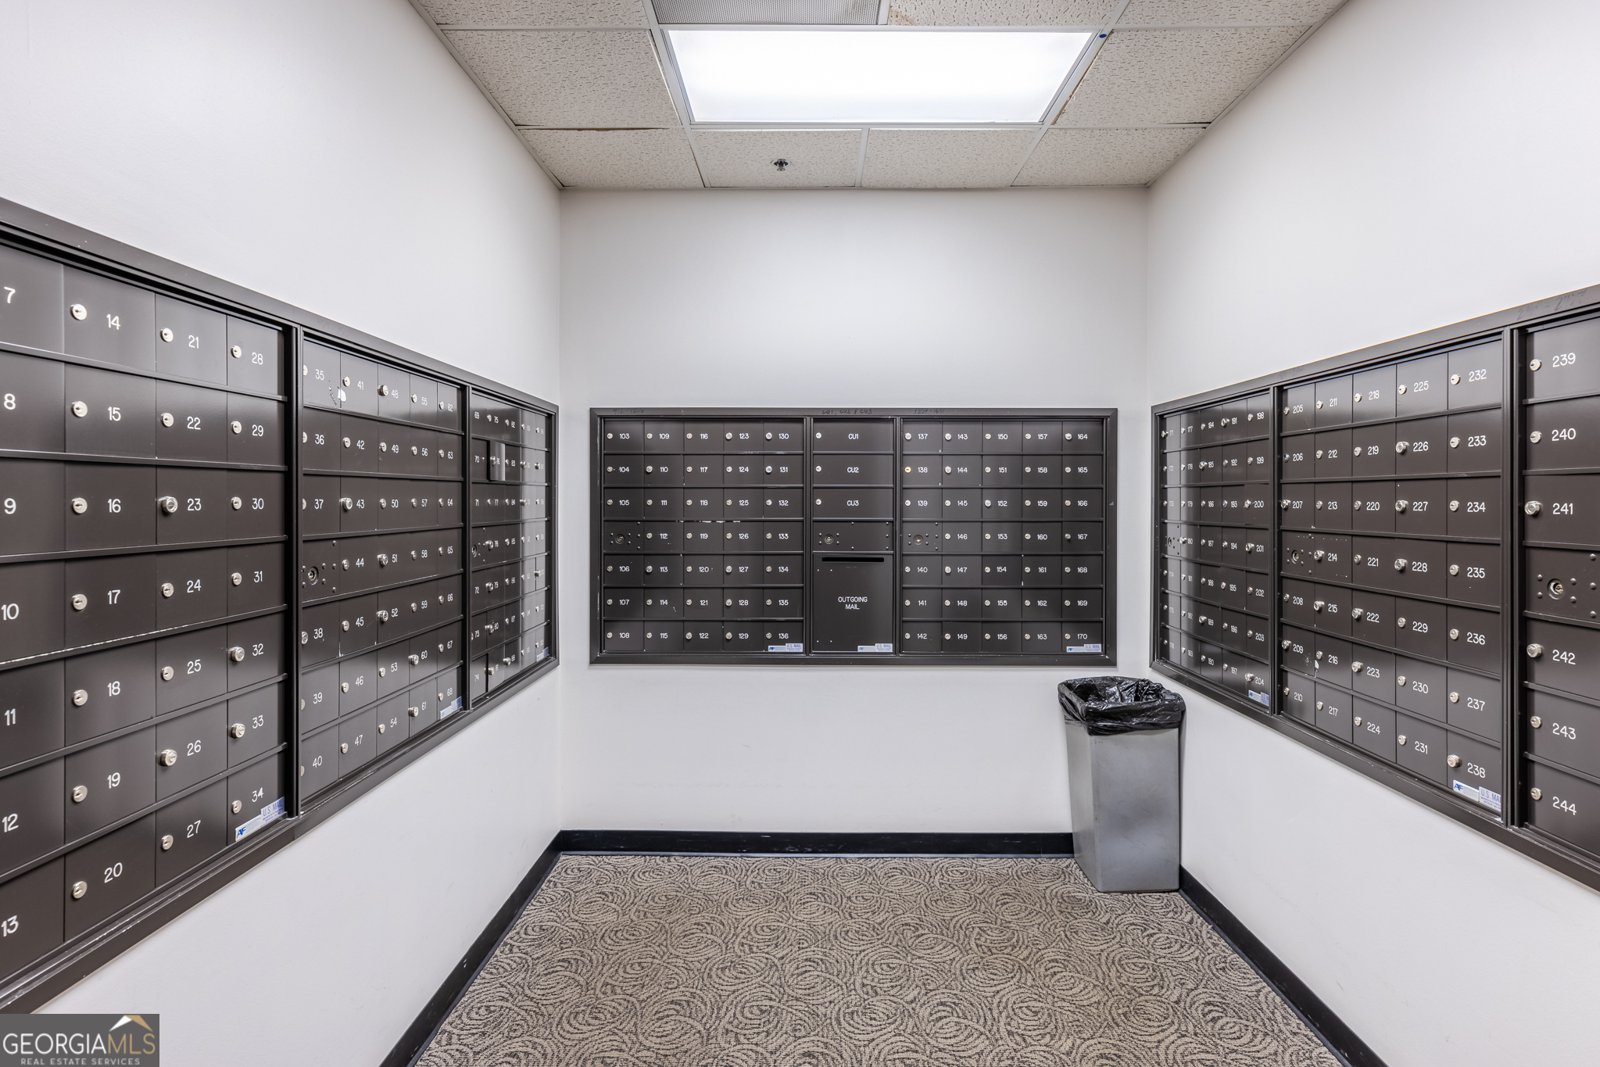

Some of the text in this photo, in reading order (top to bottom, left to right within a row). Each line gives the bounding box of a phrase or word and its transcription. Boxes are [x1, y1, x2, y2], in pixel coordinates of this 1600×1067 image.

[4, 286, 16, 304] 7
[106, 314, 121, 330] 14
[188, 335, 199, 349] 21
[251, 352, 263, 365] 28
[1552, 352, 1576, 368] 239
[315, 369, 325, 381] 35
[1468, 369, 1487, 382] 232
[1413, 380, 1429, 392] 225
[1368, 390, 1380, 400] 218
[4, 393, 16, 410] 8
[1329, 397, 1338, 407] 211
[108, 406, 121, 421] 15
[1293, 403, 1304, 414] 205
[187, 416, 201, 430] 22
[252, 424, 264, 437] 29
[1552, 428, 1576, 441] 240
[315, 434, 325, 445] 36
[356, 440, 365, 450] 42
[1468, 435, 1487, 447] 233
[391, 444, 399, 454] 49
[1368, 445, 1379, 455] 219
[1413, 441, 1429, 452] 226
[1293, 453, 1303, 462] 206
[1328, 449, 1338, 459] 212
[4, 498, 16, 514] 9
[108, 498, 121, 513] 16
[187, 498, 202, 511] 23
[252, 498, 264, 510] 30
[314, 499, 324, 510] 37
[356, 499, 365, 509] 43
[391, 499, 399, 508] 50
[1292, 500, 1303, 509] 207
[1328, 501, 1338, 510] 213
[1366, 501, 1380, 511] 220
[1413, 501, 1428, 511] 227
[1467, 502, 1486, 512] 234
[1553, 503, 1573, 515] 241
[355, 558, 364, 567] 44
[1328, 553, 1338, 562] 214
[1367, 557, 1379, 567] 221
[1412, 561, 1428, 573] 228
[1467, 567, 1485, 579] 235
[254, 571, 263, 583] 31
[187, 579, 201, 593] 24
[107, 589, 121, 605] 17
[1293, 596, 1303, 606] 208
[1, 603, 19, 621] 10
[1328, 603, 1338, 613] 215
[355, 616, 364, 627] 45
[1366, 612, 1379, 623] 222
[313, 627, 323, 639] 38
[1412, 621, 1428, 633] 229
[1467, 632, 1485, 645] 236
[252, 643, 264, 656] 32
[1293, 643, 1304, 654] 209
[1328, 654, 1338, 665] 216
[1552, 649, 1576, 665] 242
[187, 659, 201, 675] 25
[390, 662, 398, 673] 53
[1366, 666, 1380, 679] 223
[355, 675, 364, 686] 46
[107, 681, 121, 697] 18
[1412, 681, 1429, 694] 230
[313, 692, 323, 704] 39
[1294, 691, 1303, 702] 210
[1467, 697, 1485, 711] 237
[4, 708, 16, 726] 11
[1328, 706, 1338, 716] 217
[252, 715, 264, 729] 33
[1367, 722, 1381, 735] 224
[1552, 722, 1576, 740] 243
[354, 734, 363, 746] 47
[187, 740, 201, 756] 26
[1415, 741, 1428, 754] 231
[312, 755, 322, 768] 40
[1467, 762, 1486, 778] 238
[107, 772, 121, 789] 19
[252, 787, 264, 802] 34
[1552, 796, 1577, 815] 244
[2, 813, 19, 833] 12
[187, 820, 201, 838] 27
[104, 862, 123, 883] 20
[1, 915, 19, 937] 13
